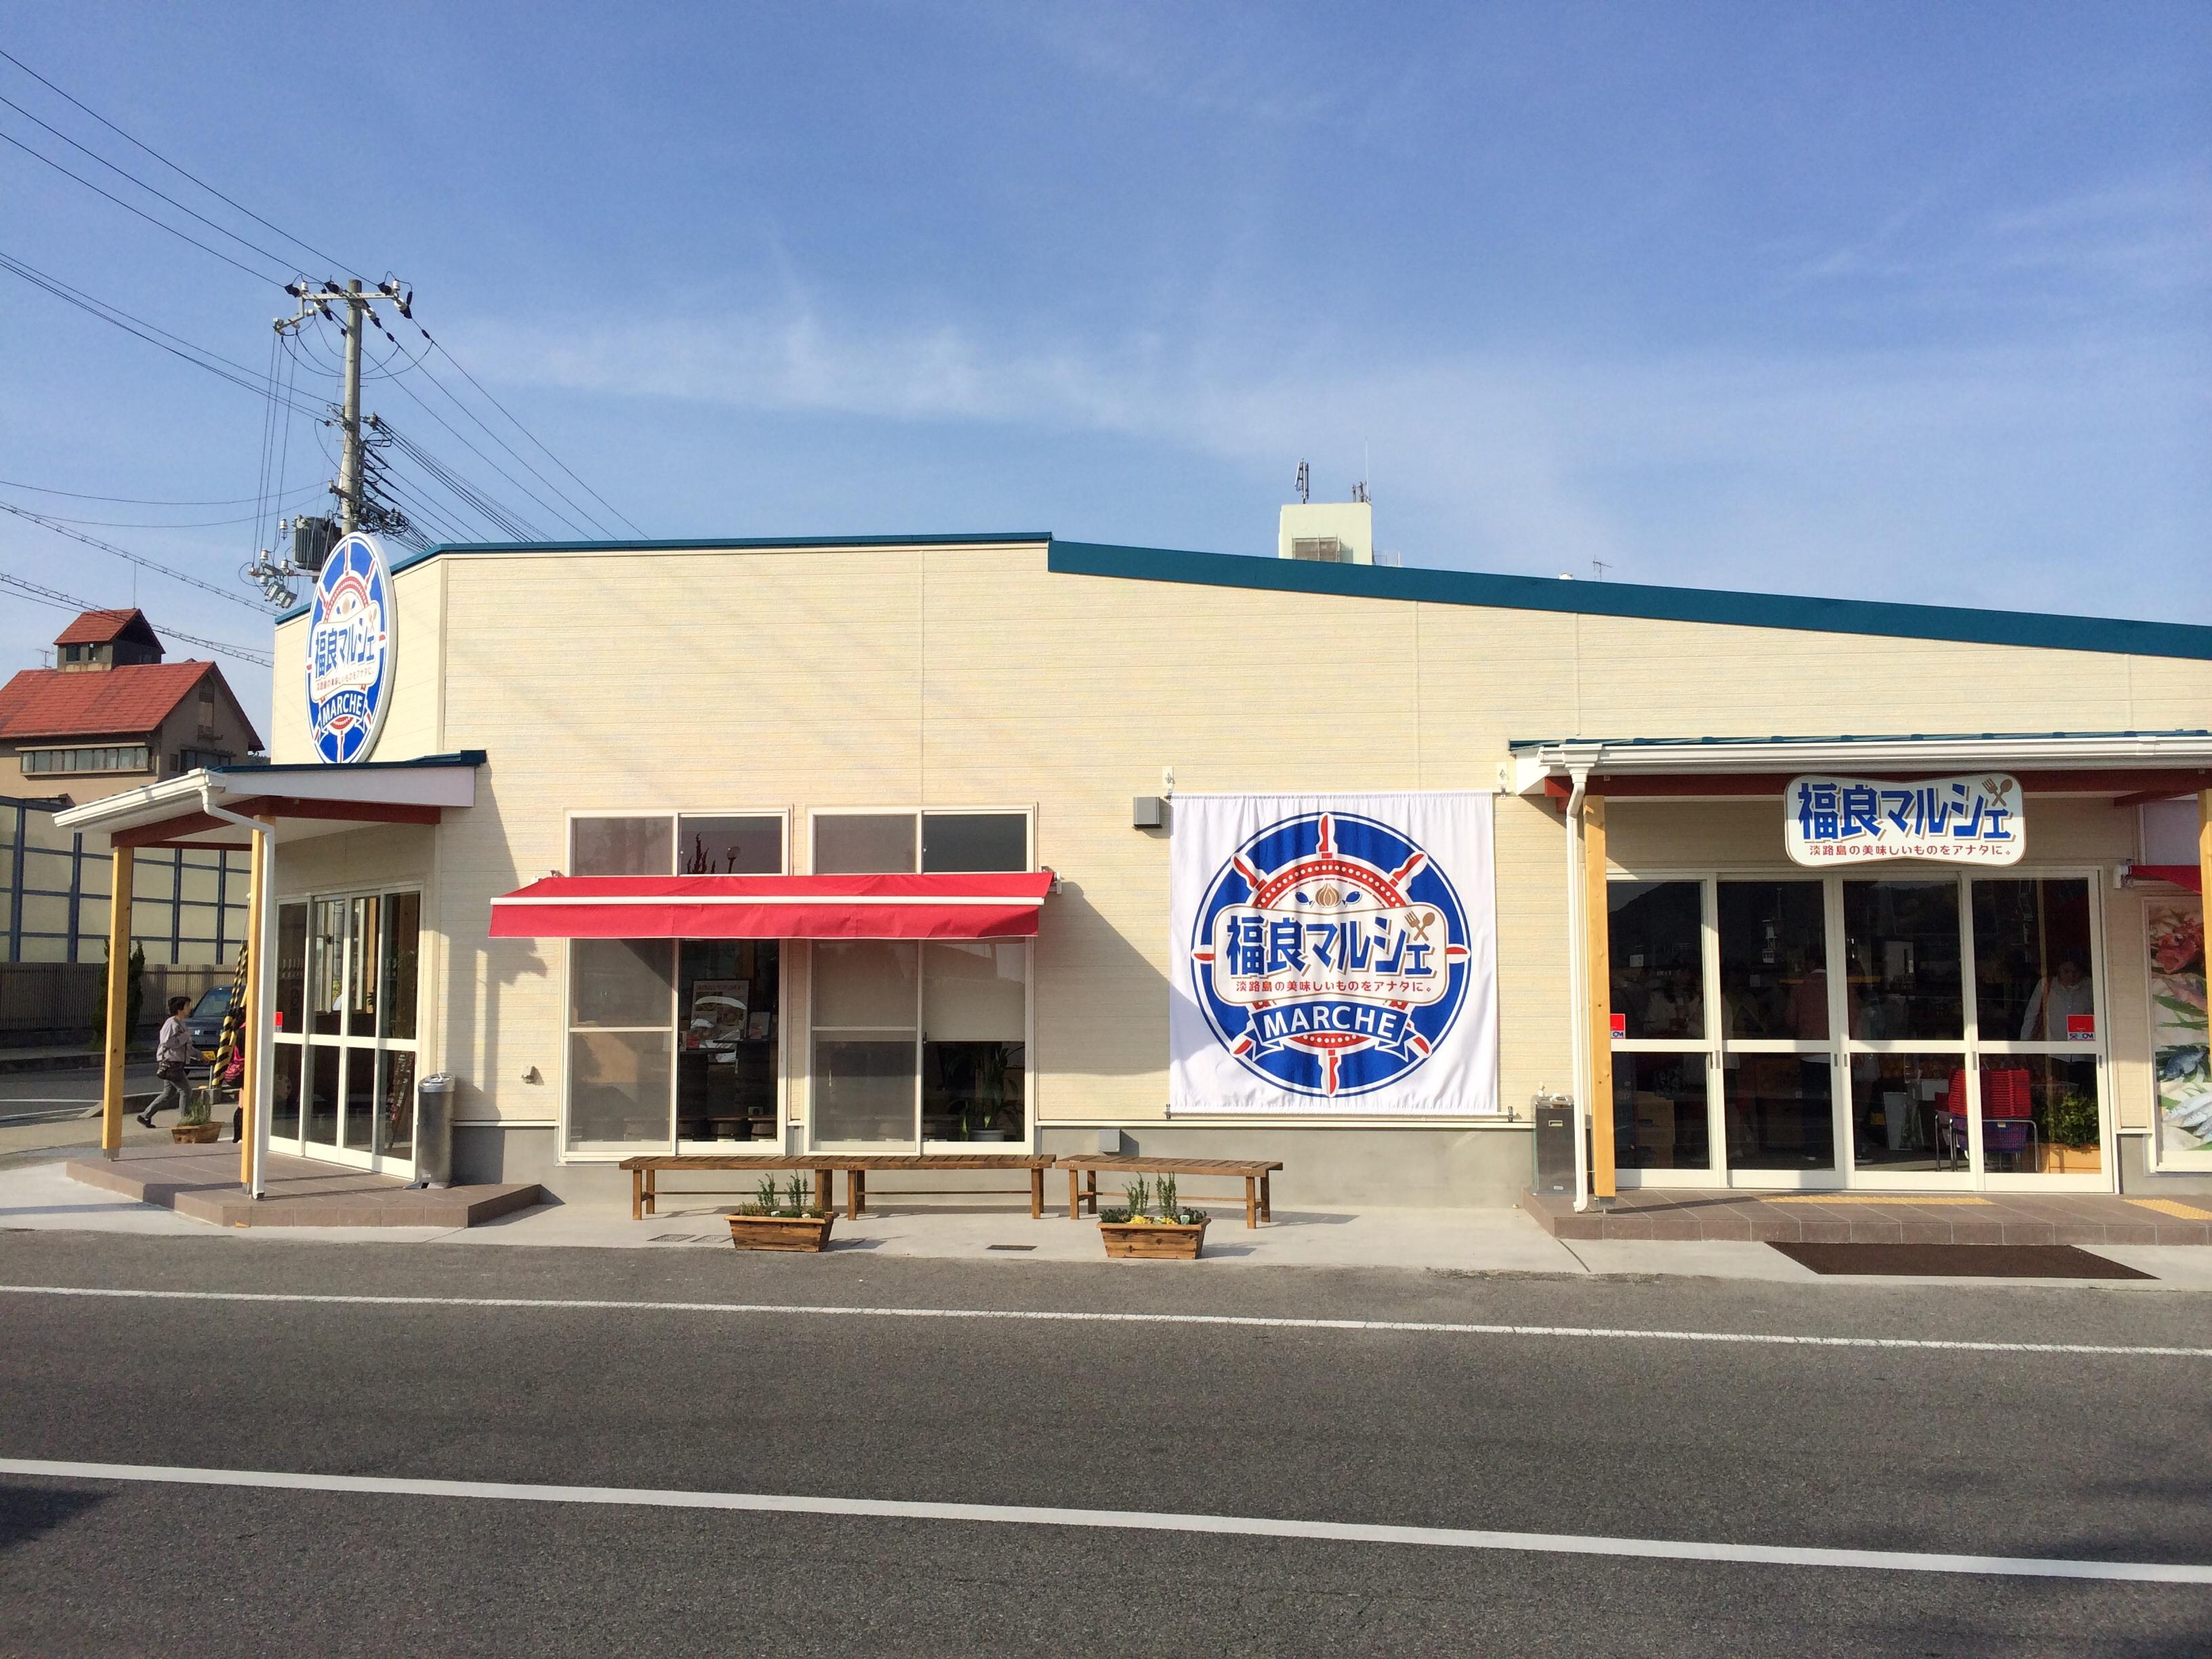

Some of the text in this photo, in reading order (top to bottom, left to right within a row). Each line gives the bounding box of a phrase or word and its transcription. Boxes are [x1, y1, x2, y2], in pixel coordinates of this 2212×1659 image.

[315, 617, 375, 679] 福良マルシェ
[323, 693, 363, 726] MARCHE
[1798, 782, 2012, 840] 福良マルシェ
[1809, 844, 2011, 856] 淡路島の美味しいものをアナタに。
[1226, 915, 1434, 976] 福良マルシェ
[1236, 981, 1431, 992] 淡路島の美味しいものをアナタに。
[1263, 1005, 1397, 1040] MARCHE
